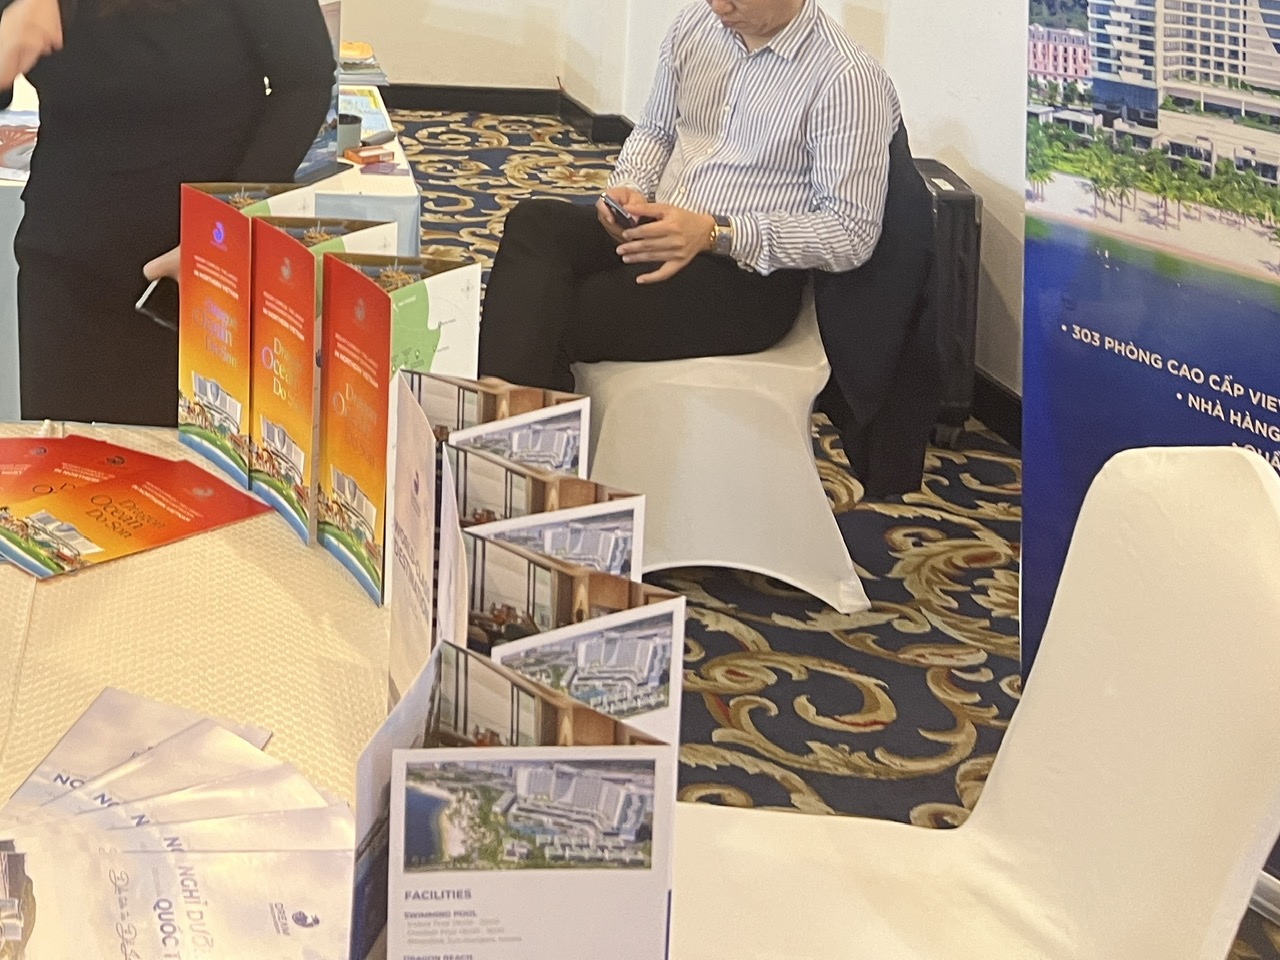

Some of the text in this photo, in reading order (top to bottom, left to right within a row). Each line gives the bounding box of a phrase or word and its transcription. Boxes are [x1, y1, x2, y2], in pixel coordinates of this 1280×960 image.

[1072, 324, 1280, 413] 303 PHÒNG CAO CẤP VIE
[1188, 393, 1280, 442] NHÀ HÀNG
[179, 865, 208, 905] NGHỈ
[404, 889, 472, 900] FACILITIES
[153, 899, 183, 947] QUỐC
